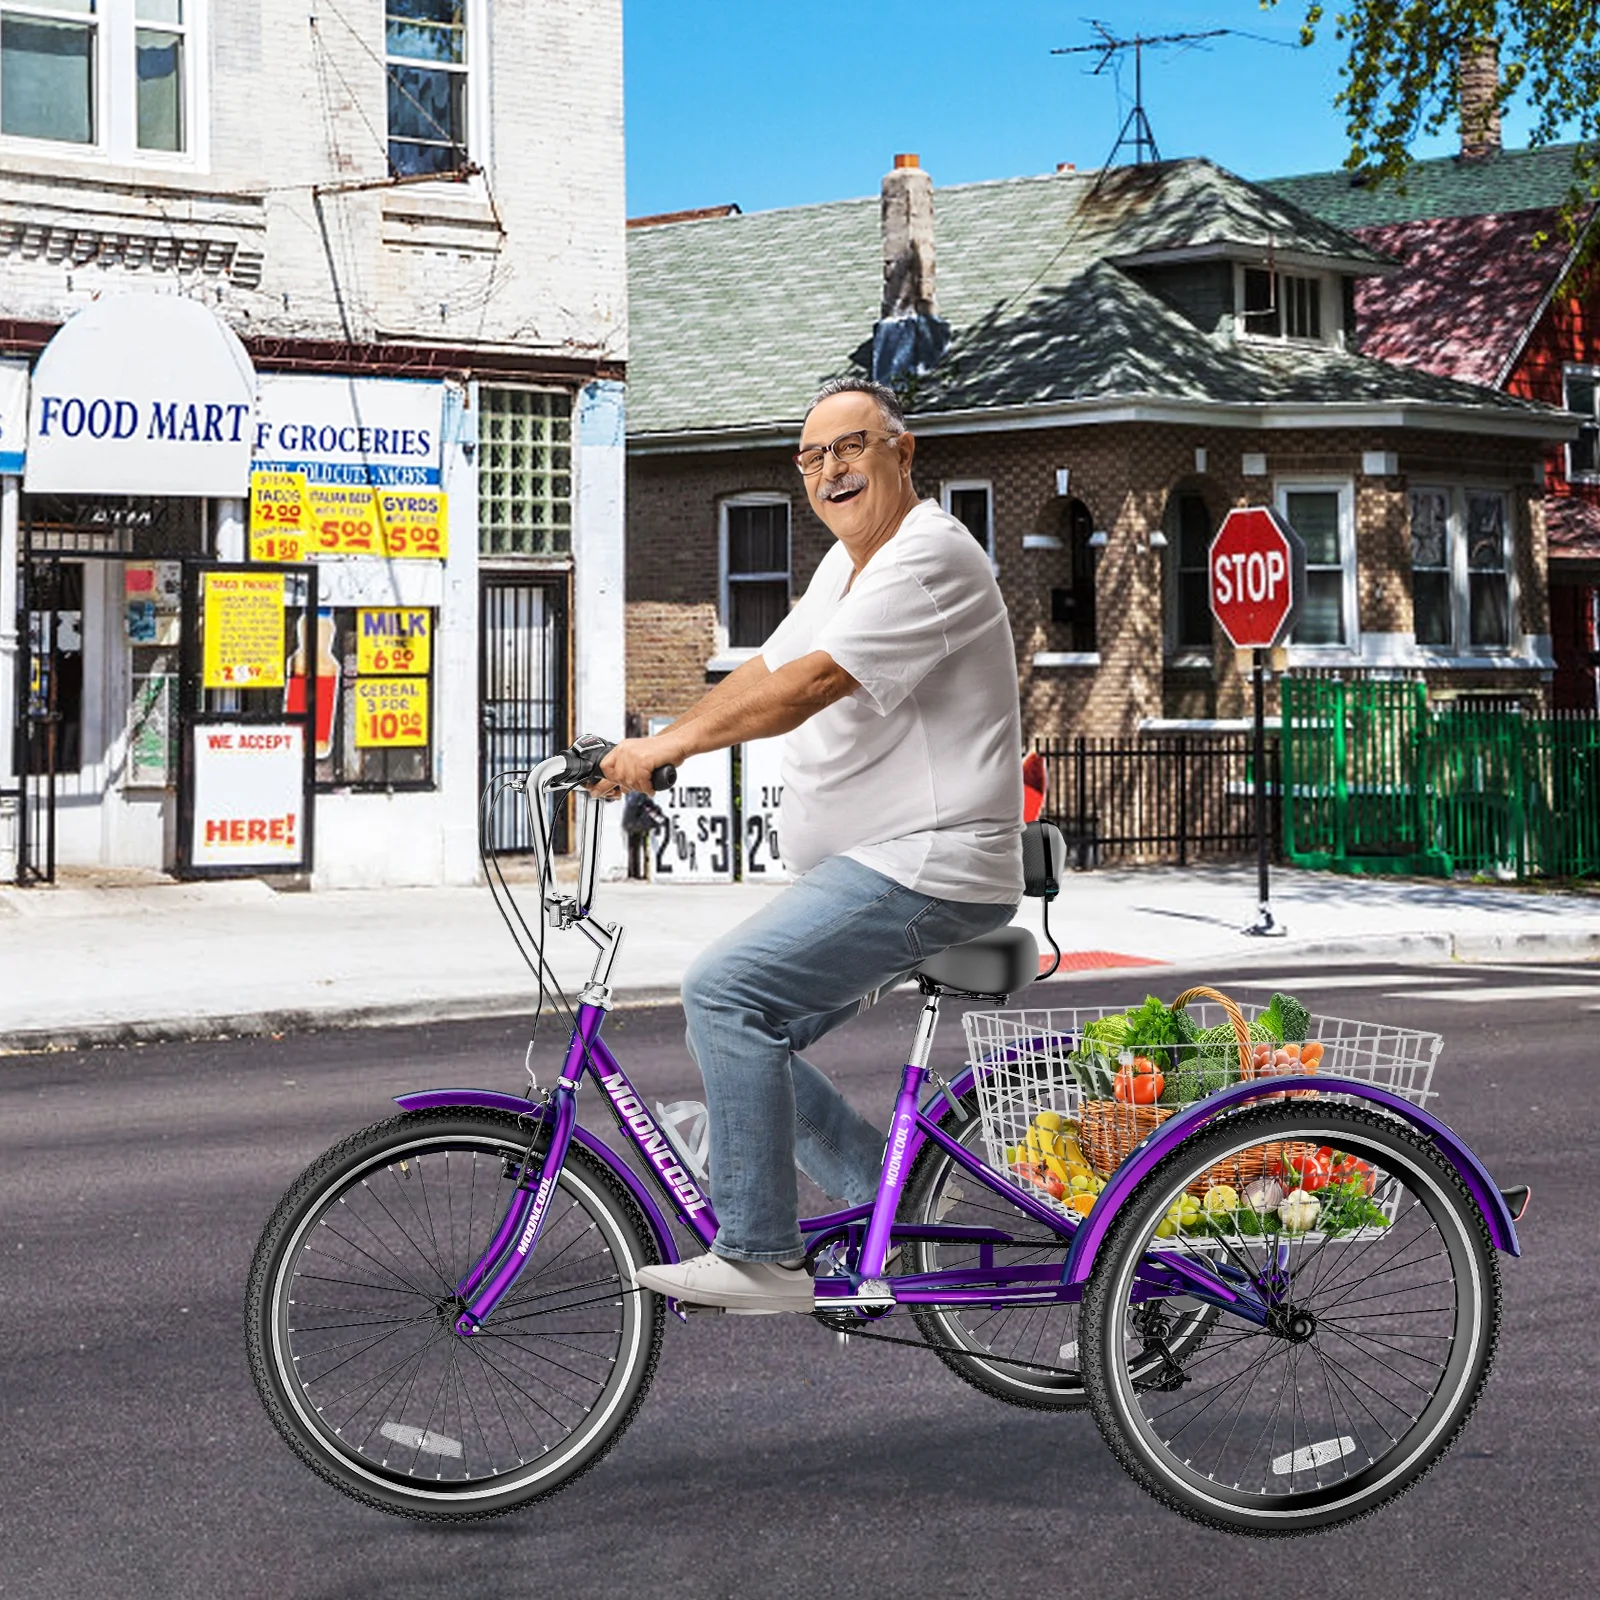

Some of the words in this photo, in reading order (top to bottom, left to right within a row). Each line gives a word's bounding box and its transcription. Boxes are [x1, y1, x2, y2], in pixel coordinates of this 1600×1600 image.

[38, 397, 138, 439] FOOD
[147, 402, 249, 442] MART
[278, 424, 431, 457] GROCERIES
[383, 496, 438, 513] GYROS
[1215, 550, 1285, 605] STOP
[363, 612, 427, 638] MILK
[360, 683, 420, 698] CEREAL
[366, 699, 376, 713] 3
[207, 735, 233, 749] WE
[238, 735, 293, 750] ACCEPT
[679, 786, 712, 808] LITER
[205, 813, 295, 846] HERE!
[746, 815, 766, 873] 2
[600, 1072, 708, 1219] MOONCOOL
[885, 1127, 909, 1188] MOONCOOL
[517, 1176, 552, 1256] MOONCOOL
